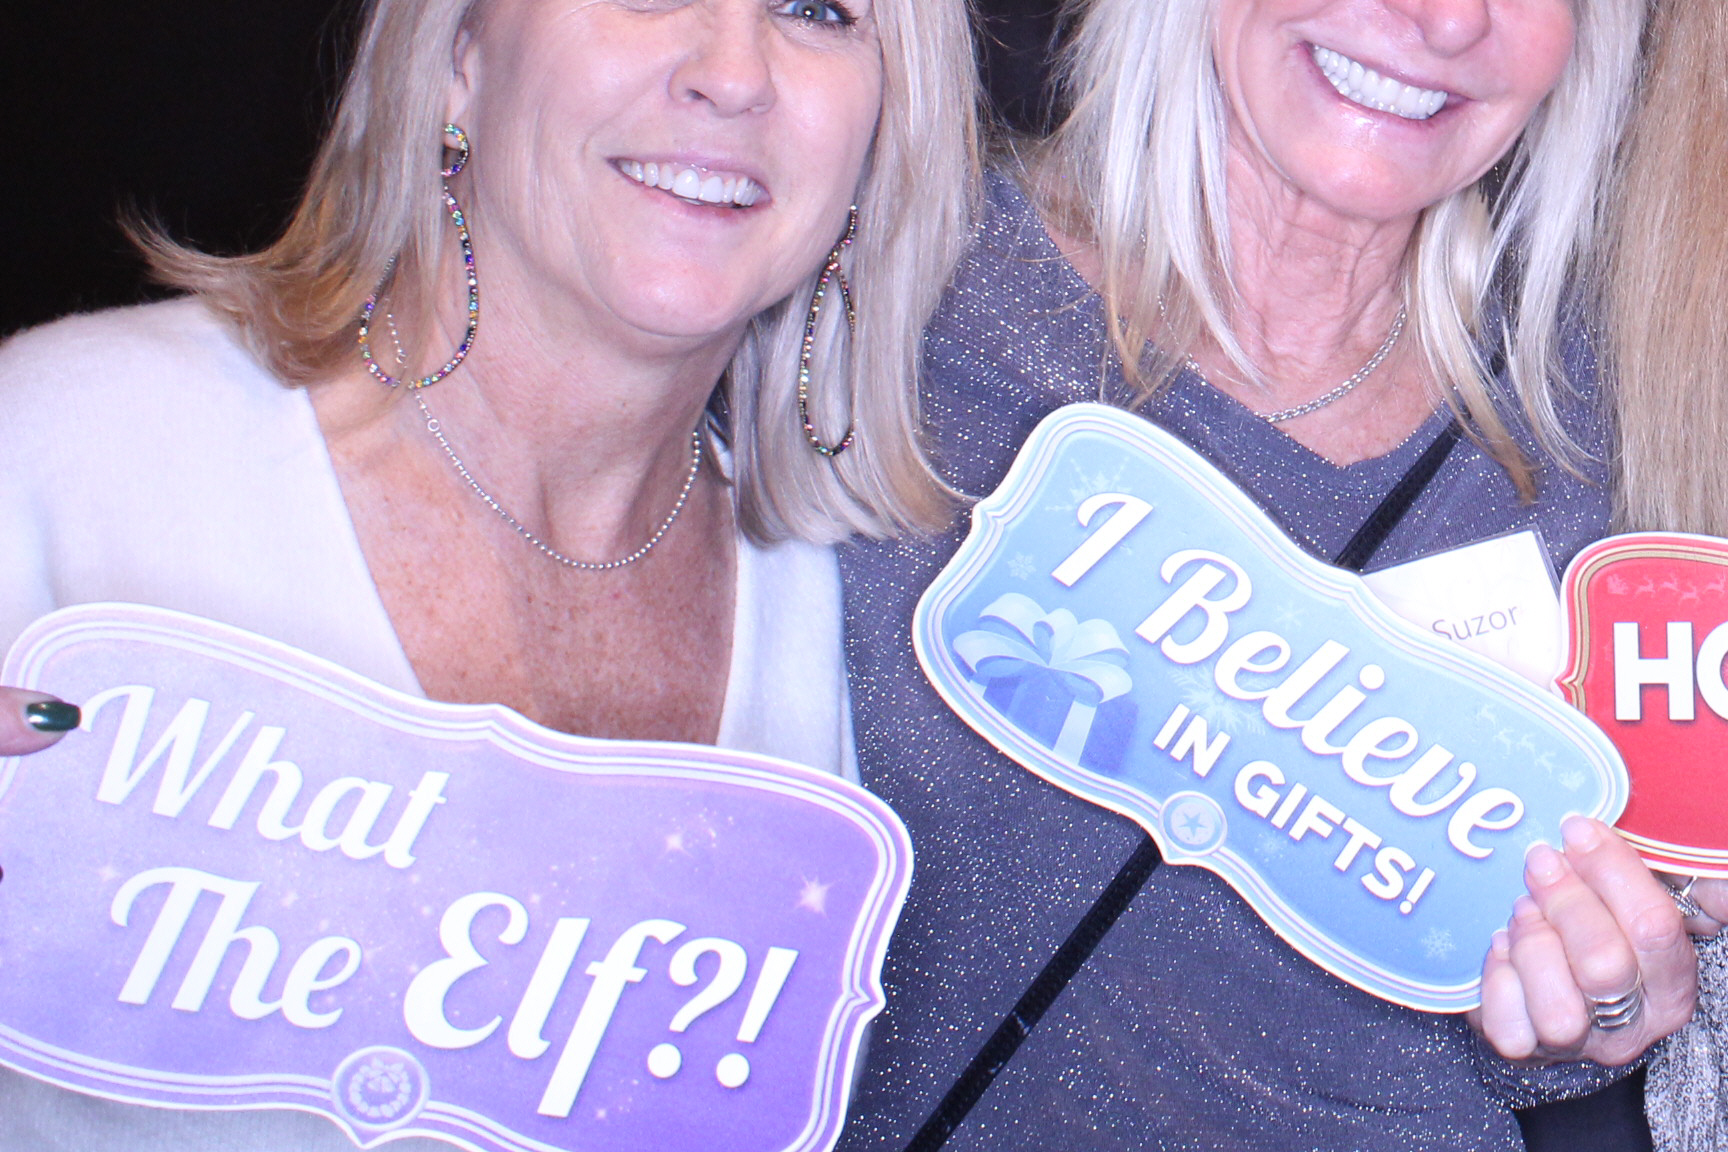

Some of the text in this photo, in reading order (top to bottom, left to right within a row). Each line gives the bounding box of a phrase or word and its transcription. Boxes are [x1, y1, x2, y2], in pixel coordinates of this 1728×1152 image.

[79, 684, 449, 868] What
[1051, 491, 1524, 858] I Believe
[1153, 705, 1435, 914] IN GIFTS!
[110, 866, 798, 1118] The Elf?!
